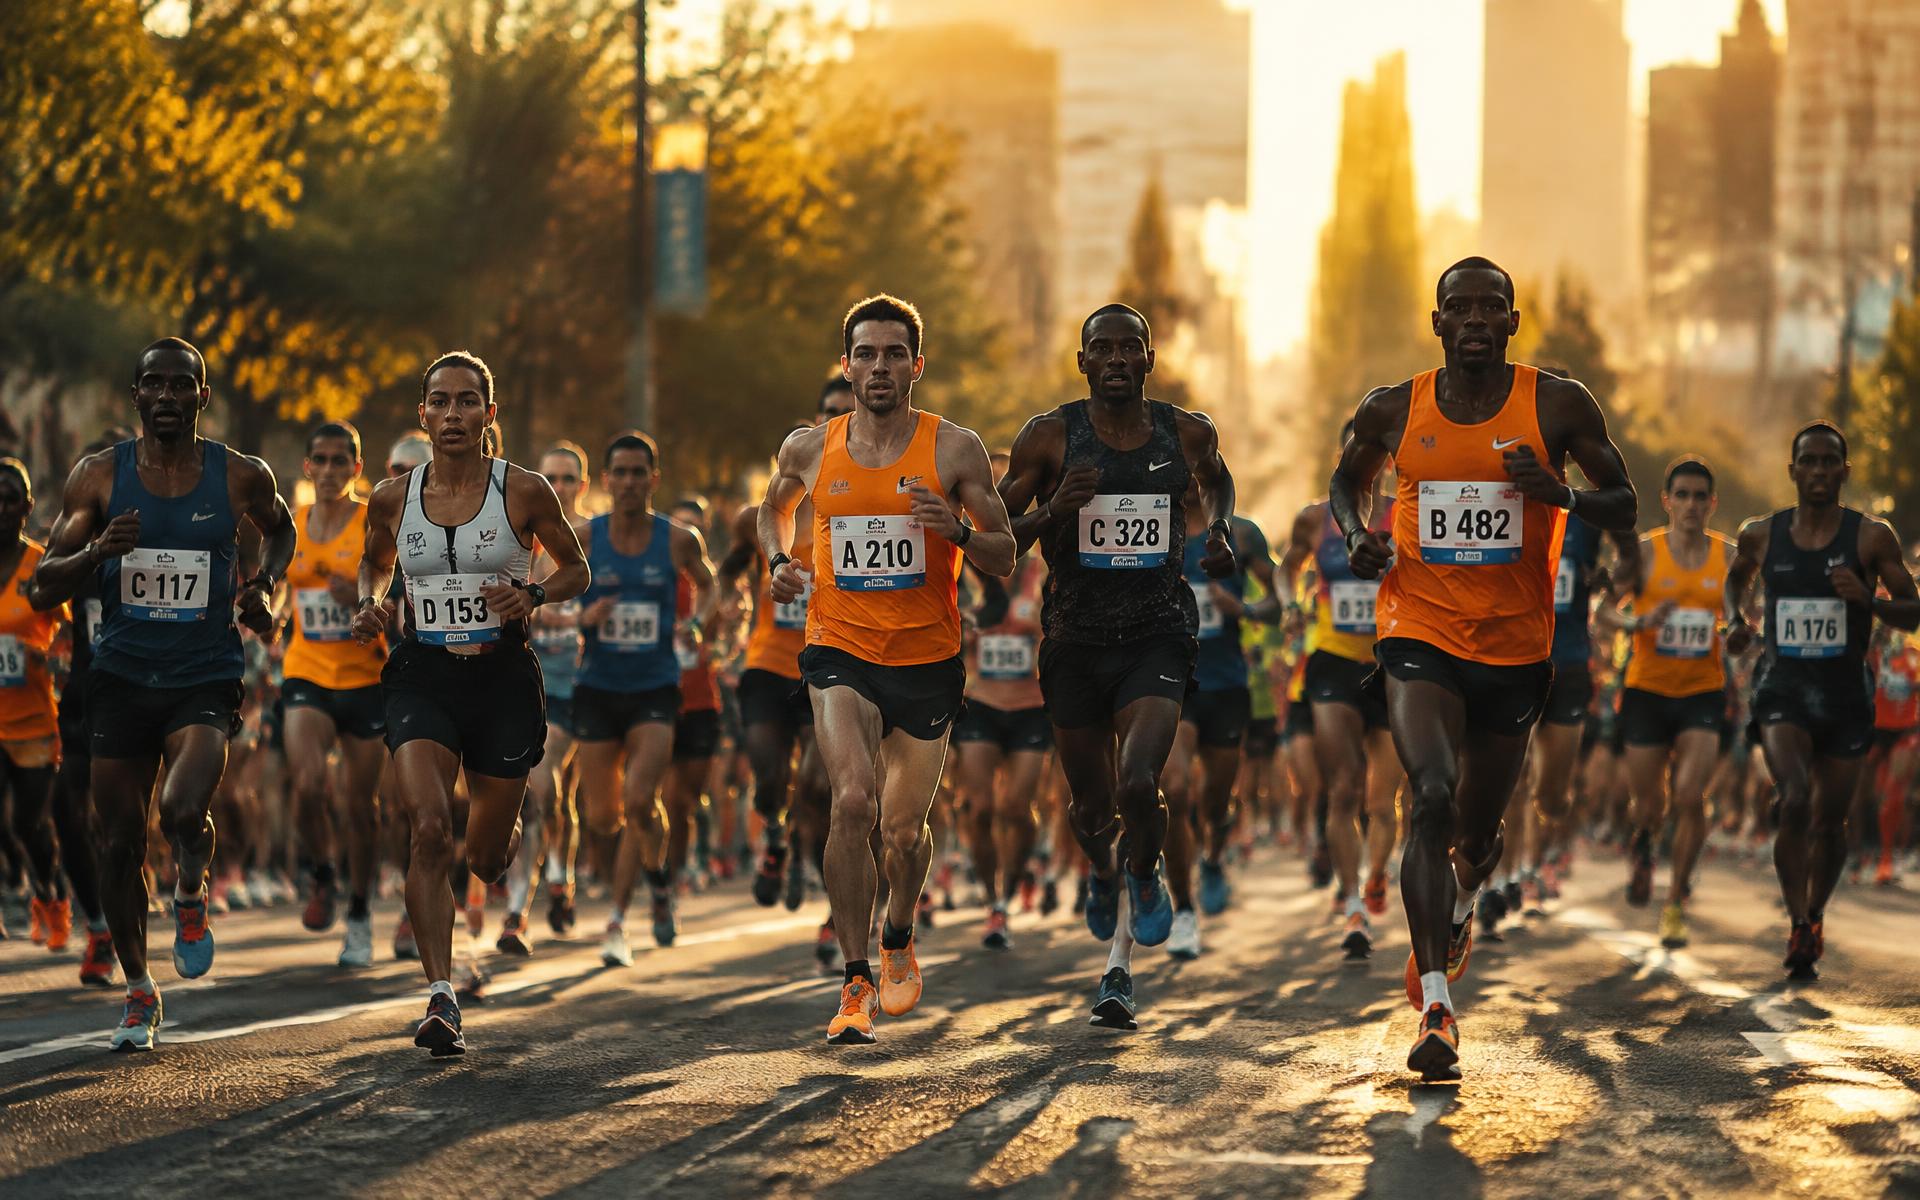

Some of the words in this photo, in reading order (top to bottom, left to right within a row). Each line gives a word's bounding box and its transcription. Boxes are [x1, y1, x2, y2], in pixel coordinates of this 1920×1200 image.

[1090, 519, 1106, 547] C
[1115, 518, 1160, 547] 328
[1431, 509, 1447, 540] B
[1456, 509, 1510, 540] 482
[843, 540, 859, 568] A
[866, 539, 913, 568] 210
[131, 572, 146, 598] C
[156, 573, 198, 600] 117
[423, 598, 436, 624] D
[445, 596, 488, 624] 153
[1784, 618, 1796, 640] A
[1803, 618, 1837, 641] 176
